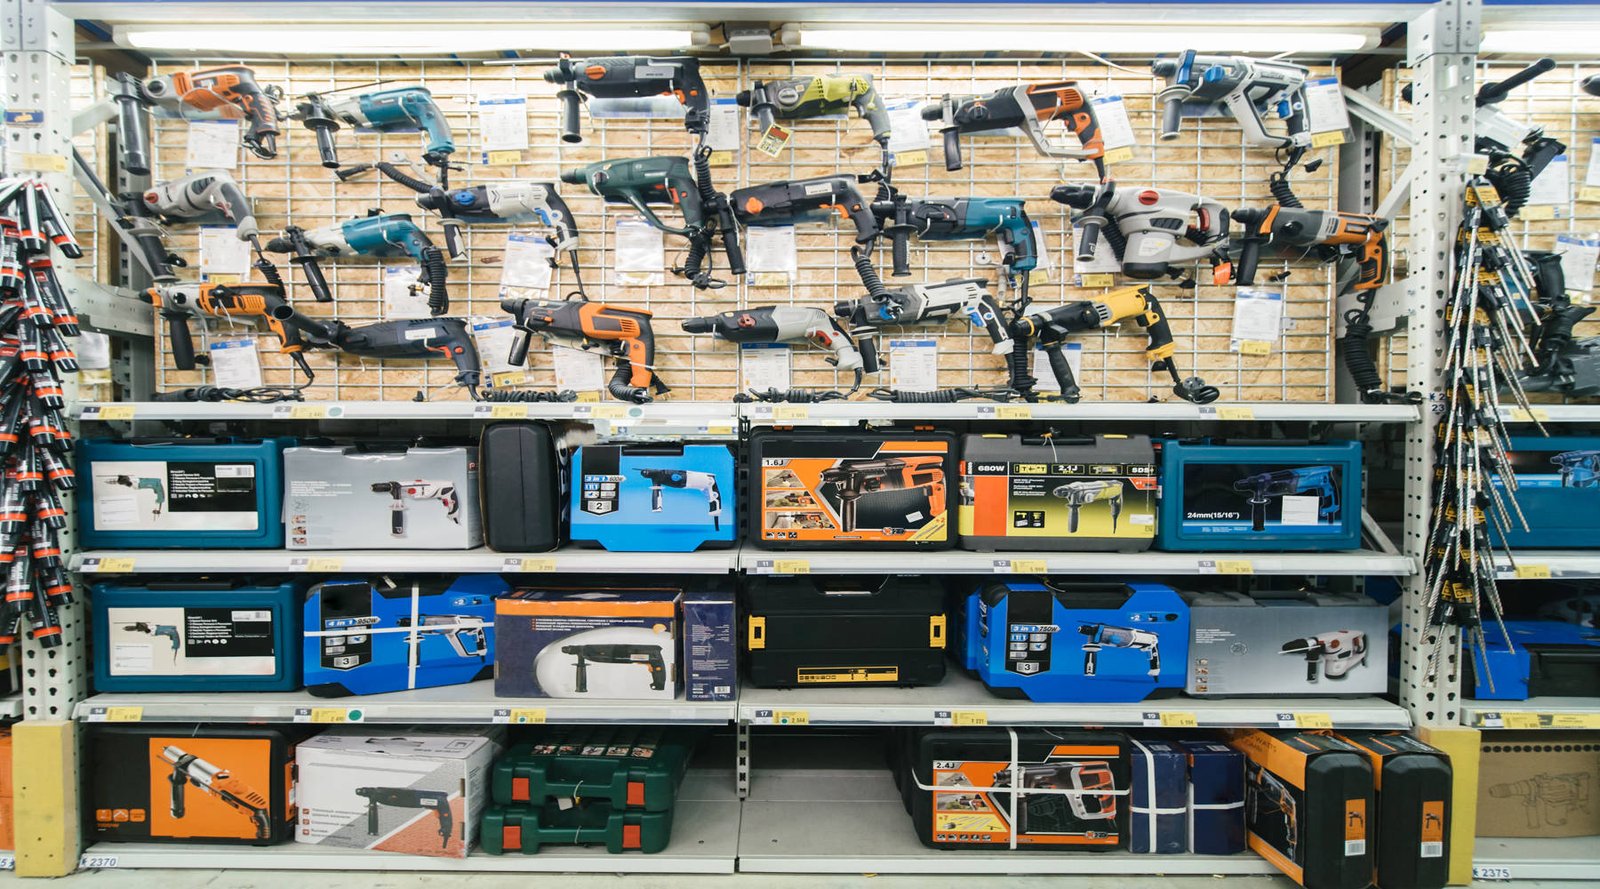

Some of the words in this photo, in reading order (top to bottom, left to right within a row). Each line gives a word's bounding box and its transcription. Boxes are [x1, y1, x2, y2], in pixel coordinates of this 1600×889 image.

[596, 502, 603, 510] 2
[89, 857, 117, 867] 2370
[1481, 868, 1510, 878] 2375
